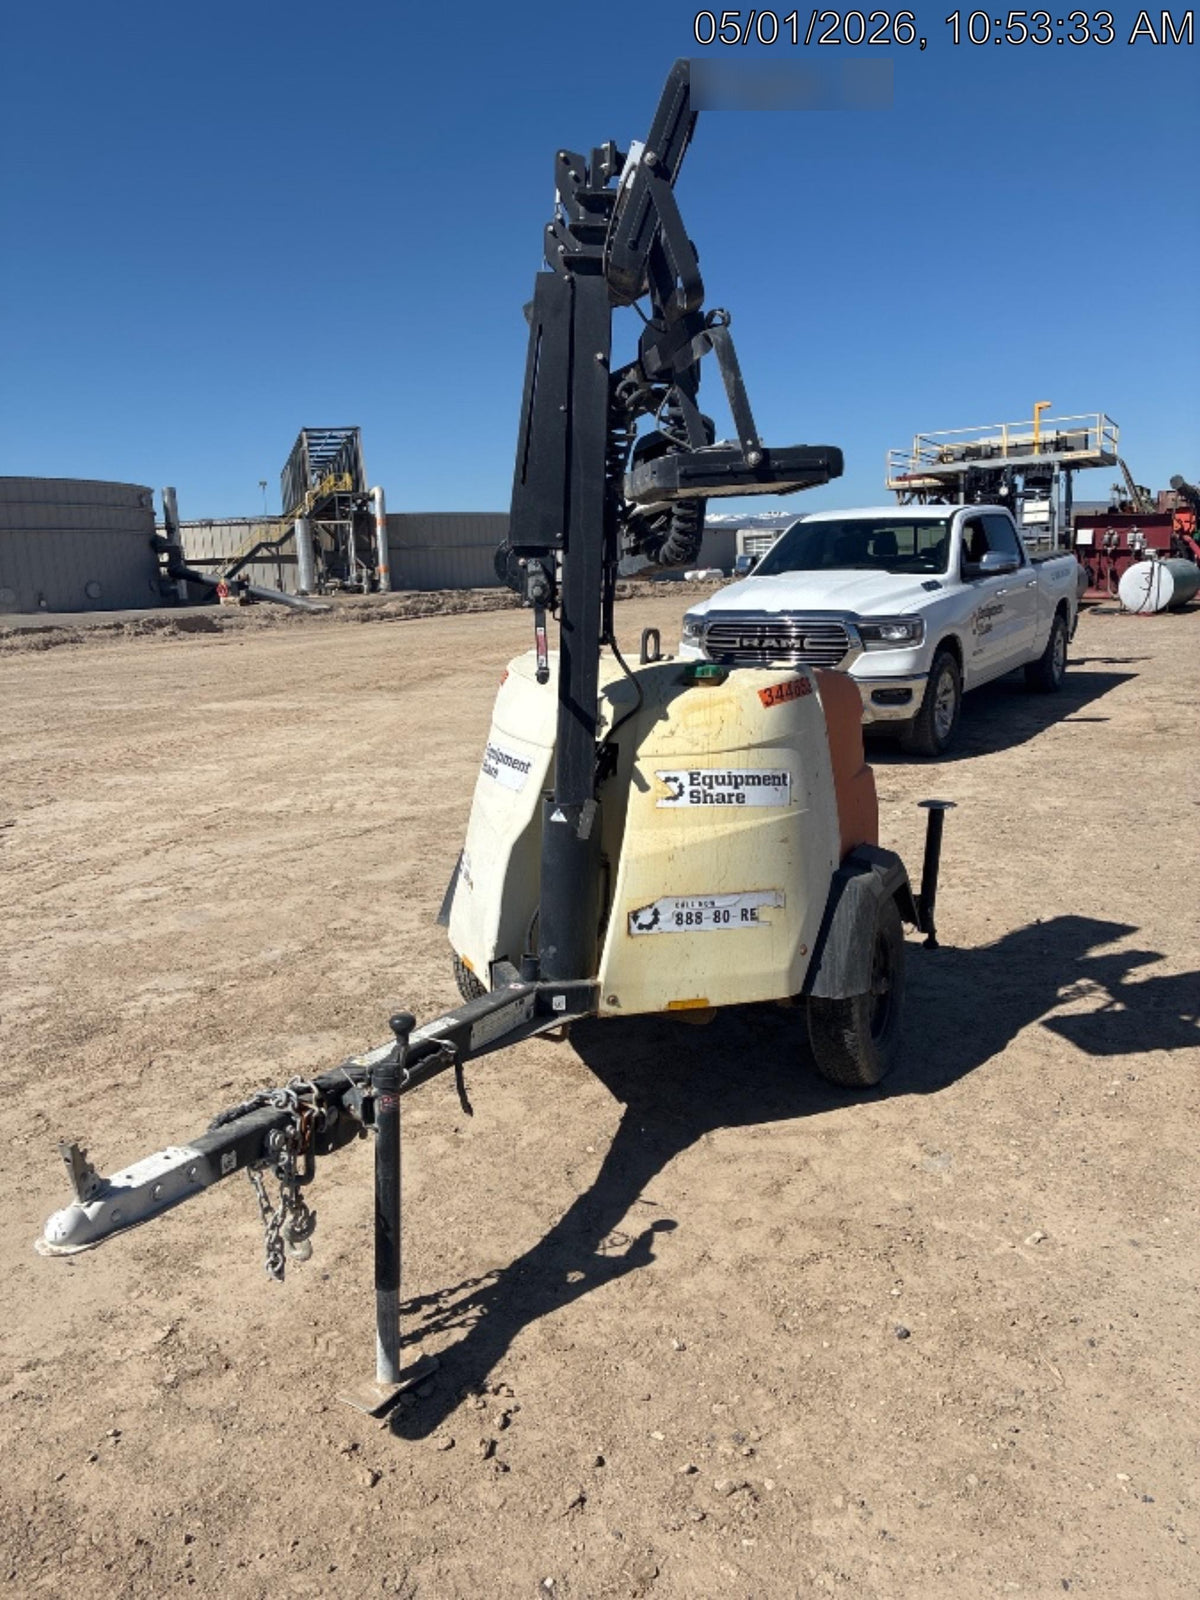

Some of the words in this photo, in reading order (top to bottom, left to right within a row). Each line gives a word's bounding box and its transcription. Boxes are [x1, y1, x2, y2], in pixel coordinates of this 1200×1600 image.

[742, 637, 801, 649] RAM
[688, 771, 788, 790] Equipment
[689, 789, 746, 804] Share
